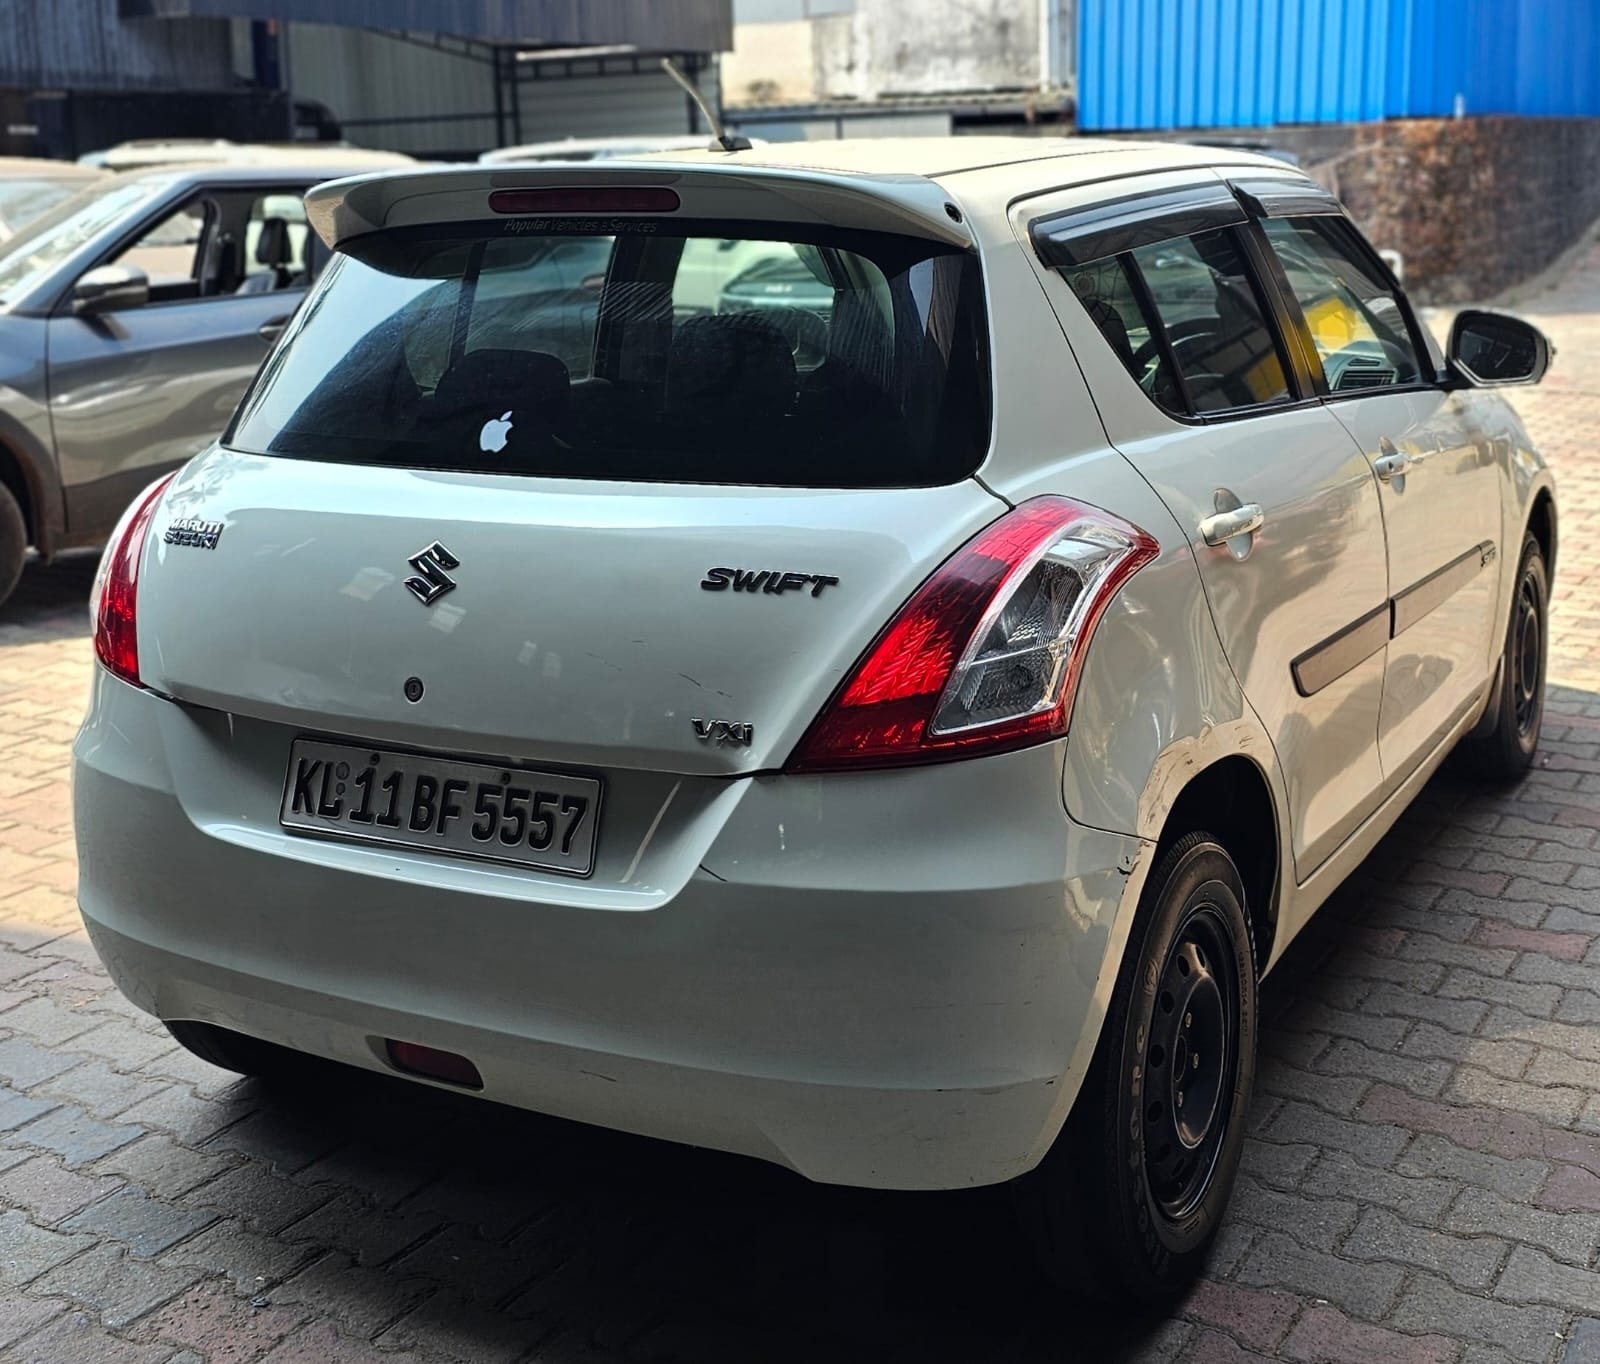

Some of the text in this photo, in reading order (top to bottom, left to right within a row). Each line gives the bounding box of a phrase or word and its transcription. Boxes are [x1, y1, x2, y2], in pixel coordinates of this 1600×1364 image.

[504, 218, 549, 233] Popular
[551, 219, 597, 232] Vehicles
[608, 219, 657, 233] Services
[169, 519, 224, 535] MARUTI
[164, 531, 219, 550] SUZUKI
[701, 567, 839, 598] SWIFT
[292, 758, 589, 855] KL 11 BF 5557
